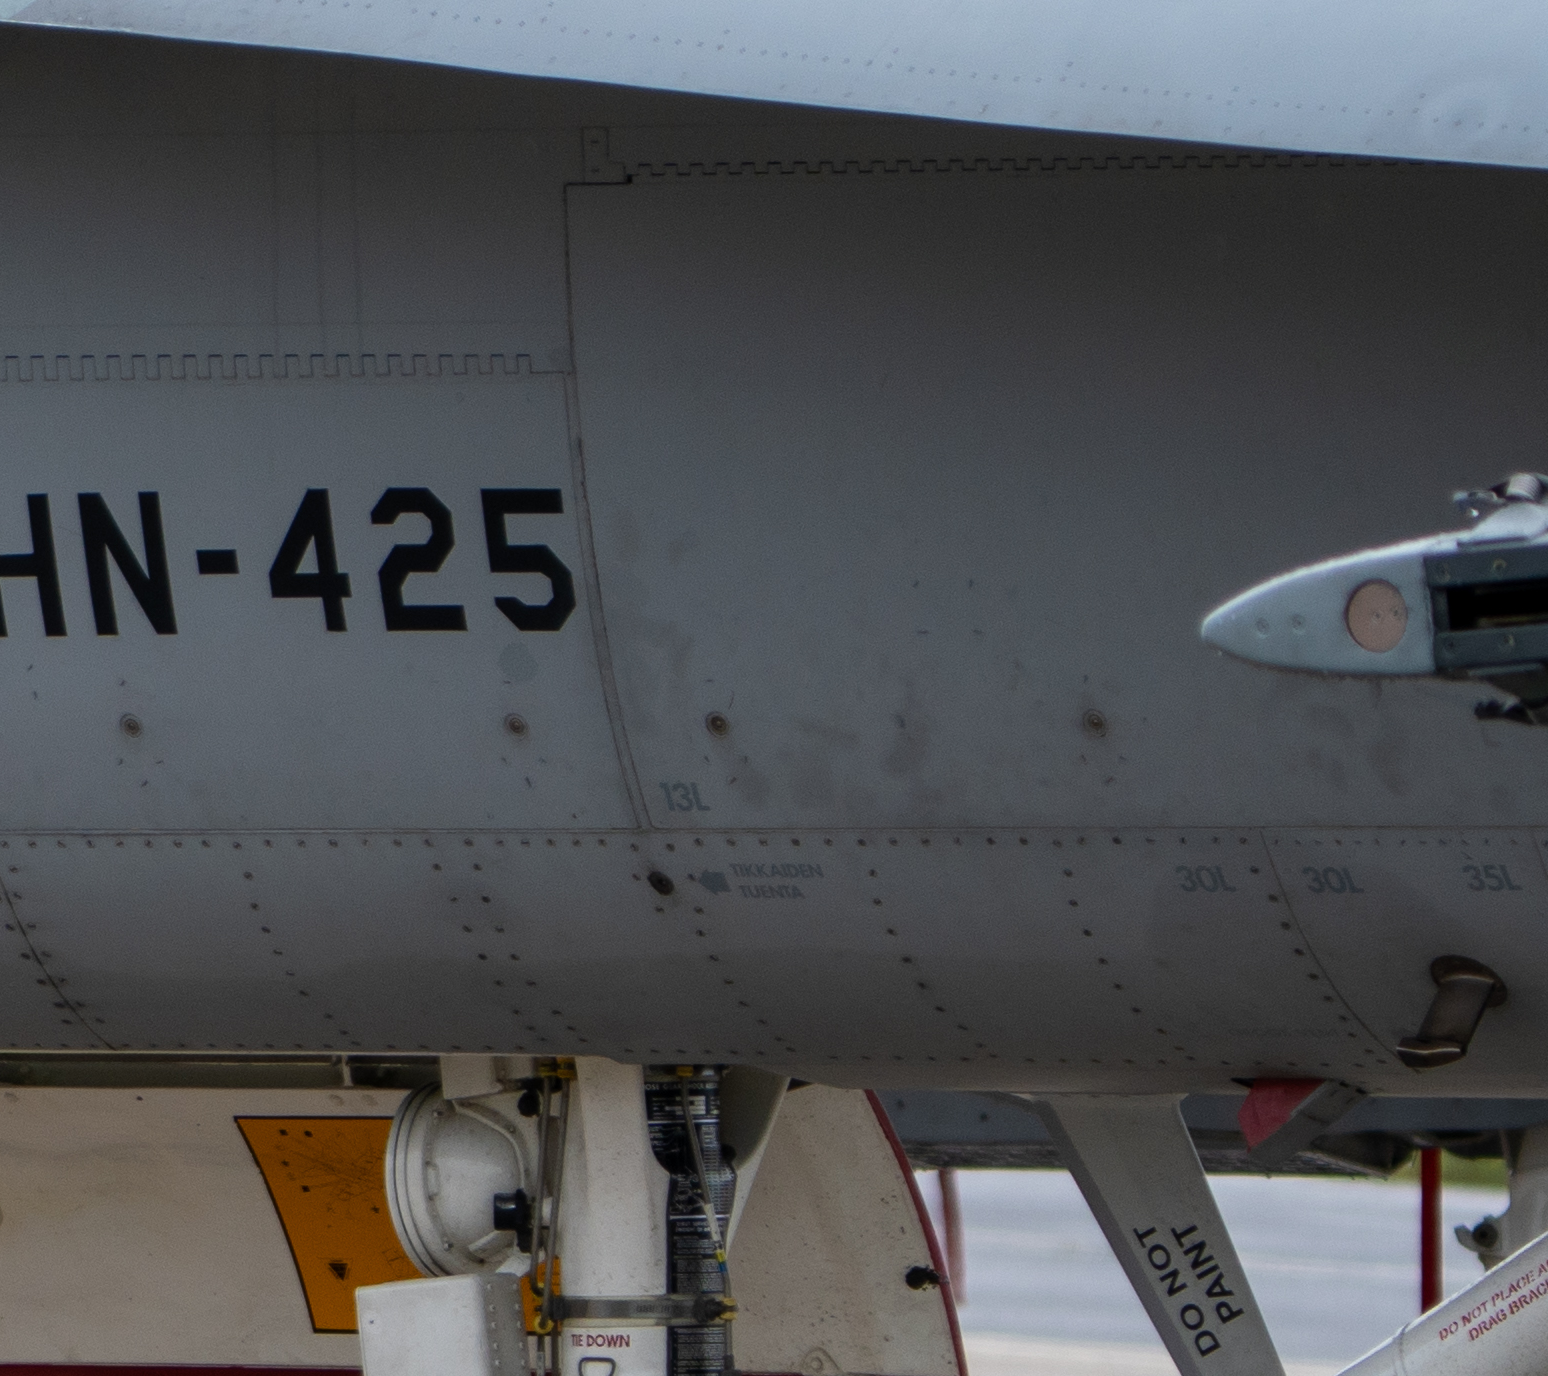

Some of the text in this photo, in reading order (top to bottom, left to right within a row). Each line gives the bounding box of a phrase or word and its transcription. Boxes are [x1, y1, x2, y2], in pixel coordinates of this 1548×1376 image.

[659, 782, 711, 812] 13L
[729, 863, 825, 878] TIKKAIDEN
[1176, 865, 1237, 893] 30L
[1303, 866, 1364, 894] 30L
[1463, 864, 1523, 892] 35L
[738, 884, 806, 899] TUENTA
[1170, 1224, 1245, 1324] PAINT
[1133, 1226, 1222, 1358] DO NOT
[1438, 1321, 1459, 1341] DO
[1461, 1300, 1488, 1327] NOT
[1491, 1269, 1536, 1307] PLACE
[1468, 1308, 1508, 1341] DRAG
[571, 1334, 631, 1348] TIE DOWN
